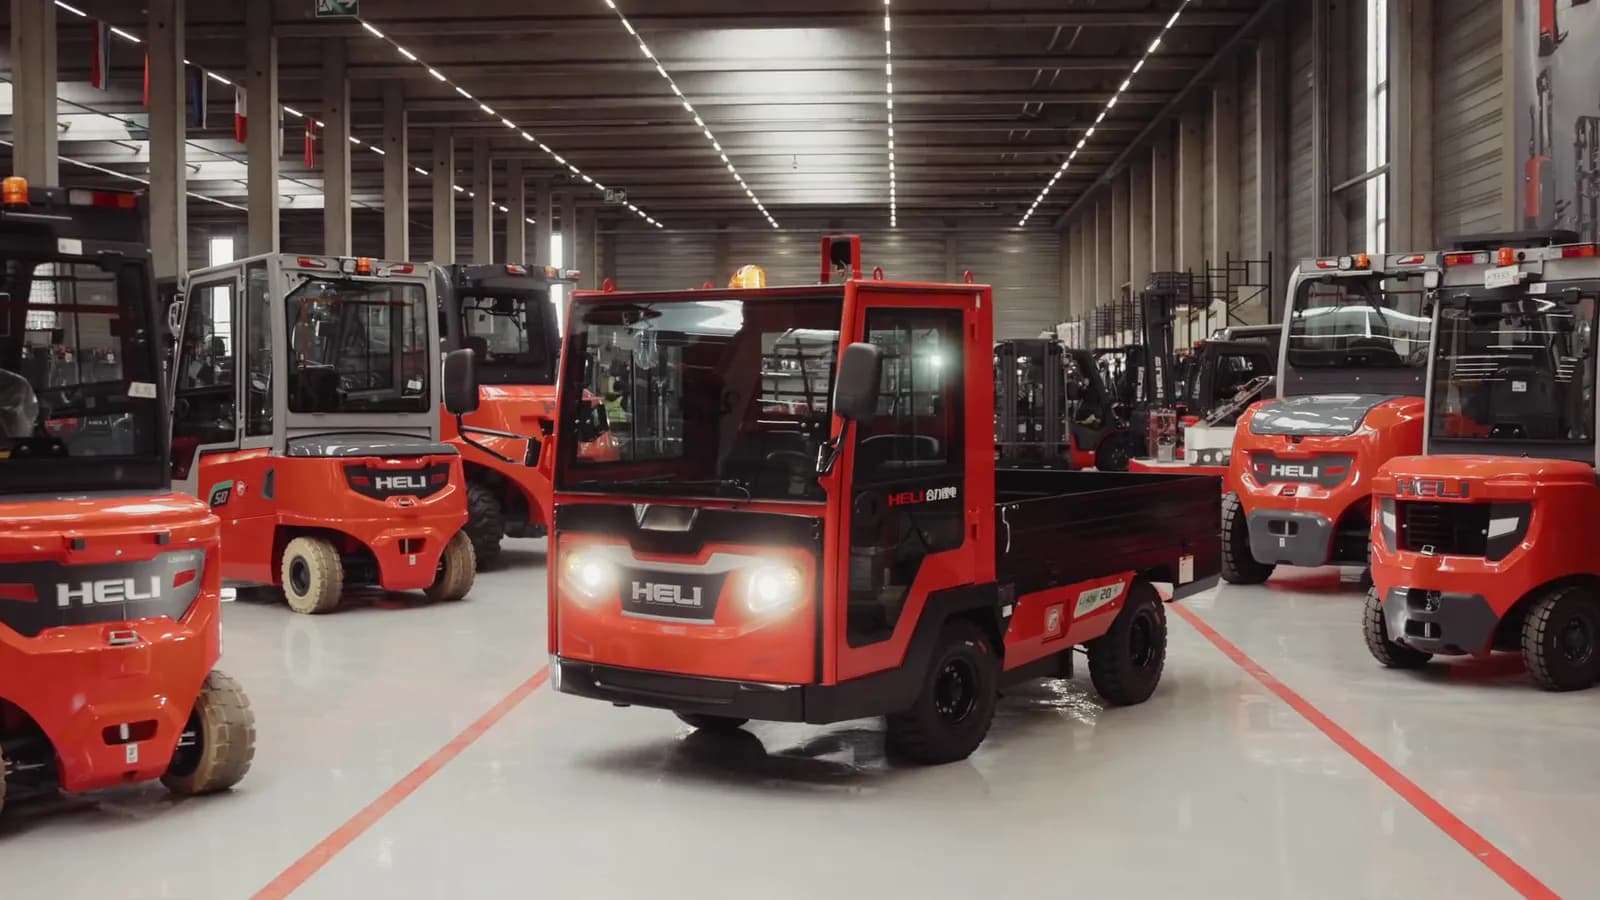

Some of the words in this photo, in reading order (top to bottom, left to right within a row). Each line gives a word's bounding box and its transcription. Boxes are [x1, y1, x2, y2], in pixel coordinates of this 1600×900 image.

[1271, 464, 1319, 478] HELI
[375, 475, 427, 489] HELI
[1397, 479, 1469, 498] HELI
[888, 489, 925, 506] HELI
[56, 576, 161, 607] HELI
[632, 581, 702, 607] HELI
[1101, 587, 1112, 600] 20
